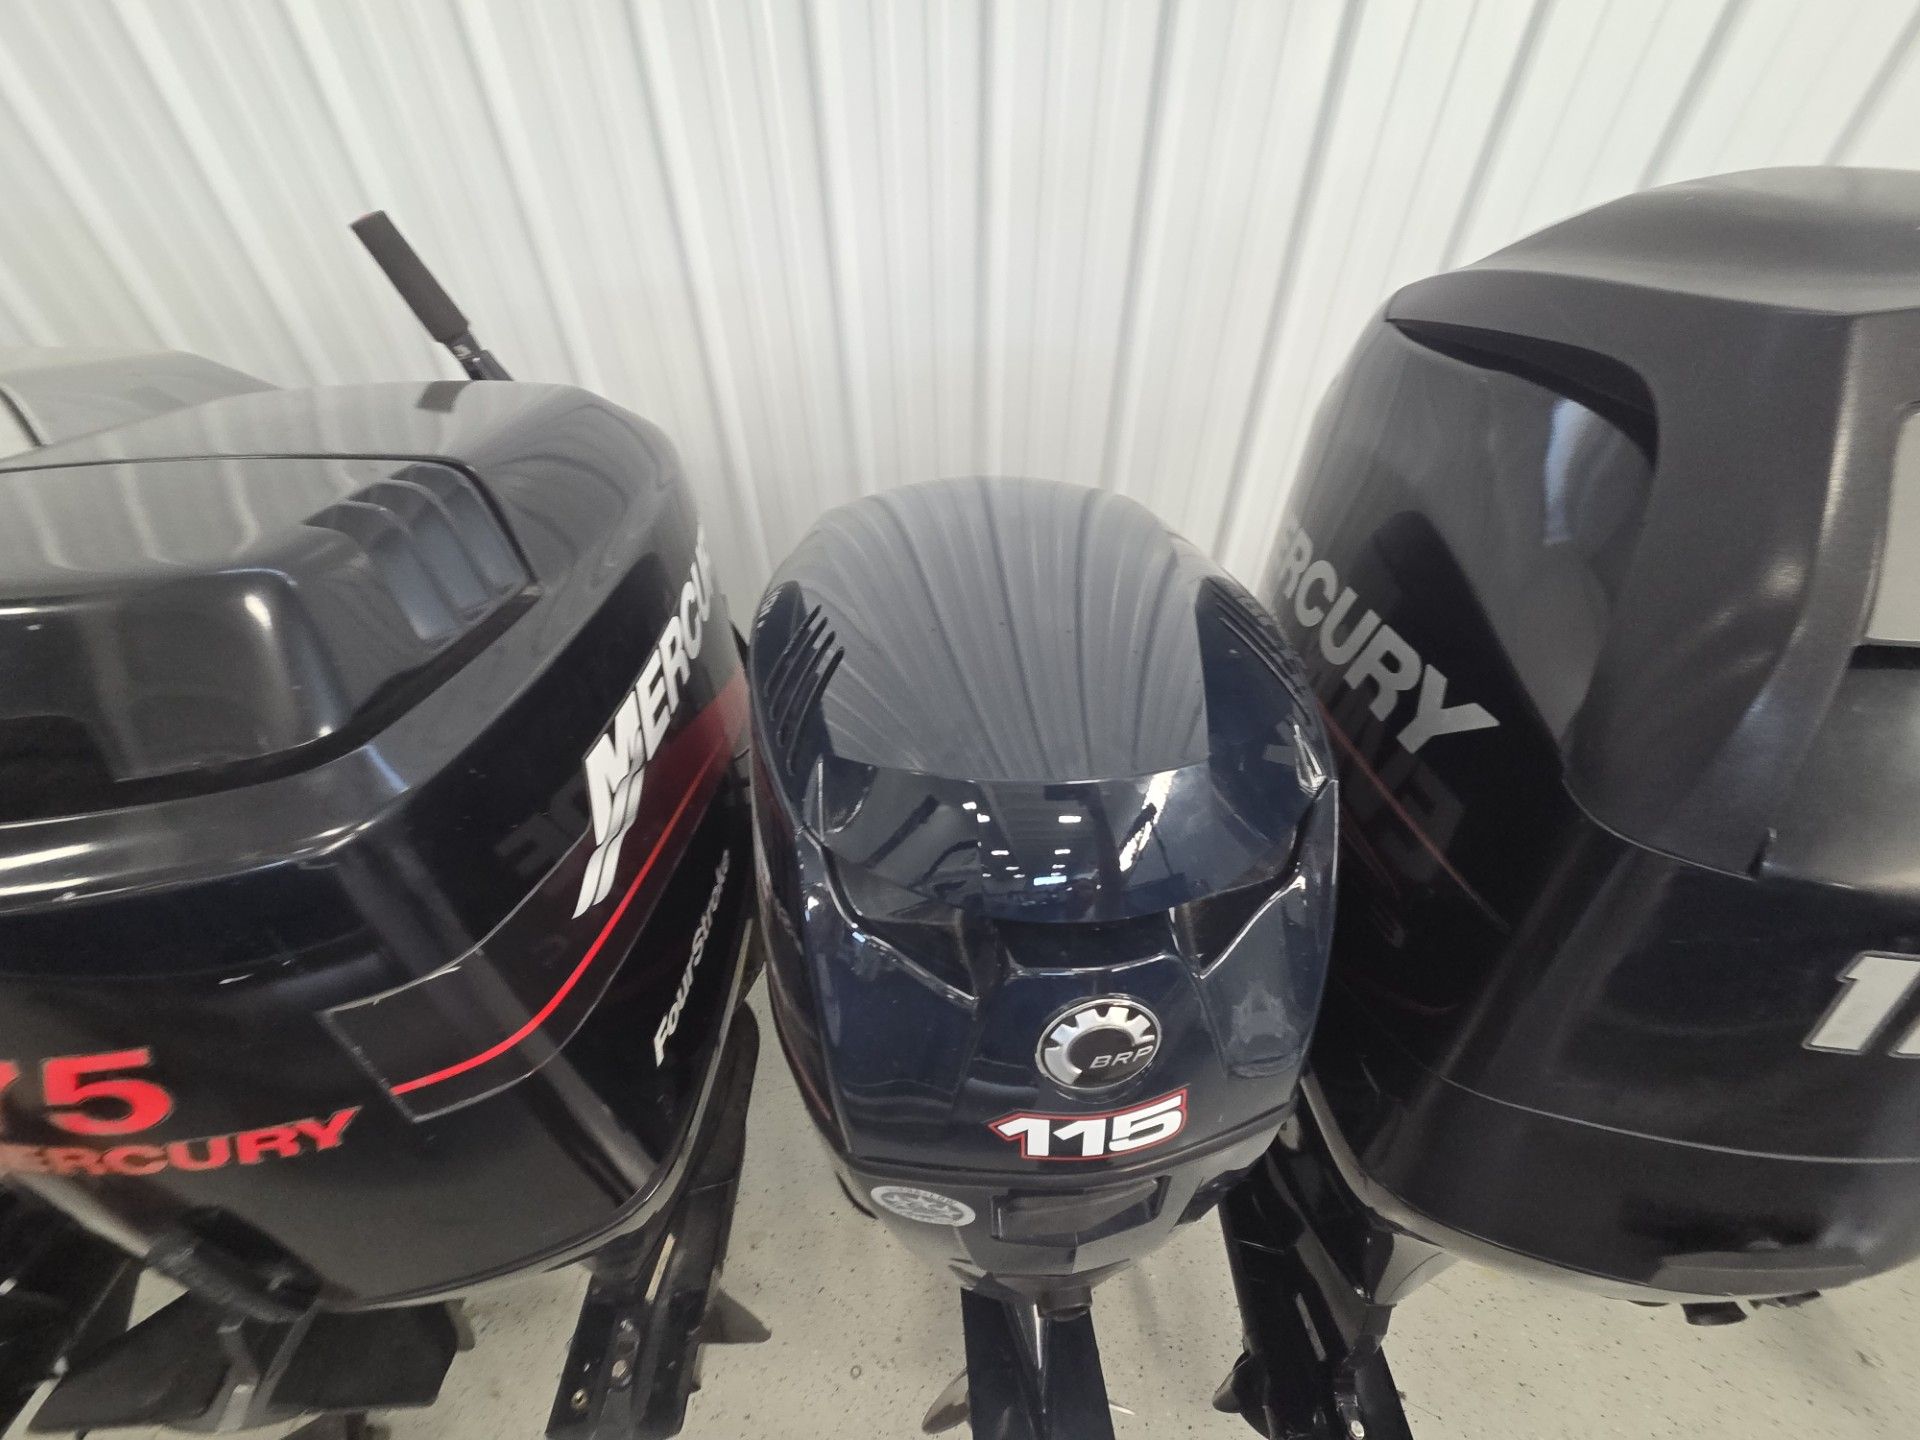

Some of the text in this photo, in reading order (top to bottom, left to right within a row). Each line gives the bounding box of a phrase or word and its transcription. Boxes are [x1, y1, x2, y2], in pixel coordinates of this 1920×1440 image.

[1802, 950, 1920, 1059] 1
[1089, 1045, 1154, 1070] BRP
[990, 1089, 1188, 1160] 115
